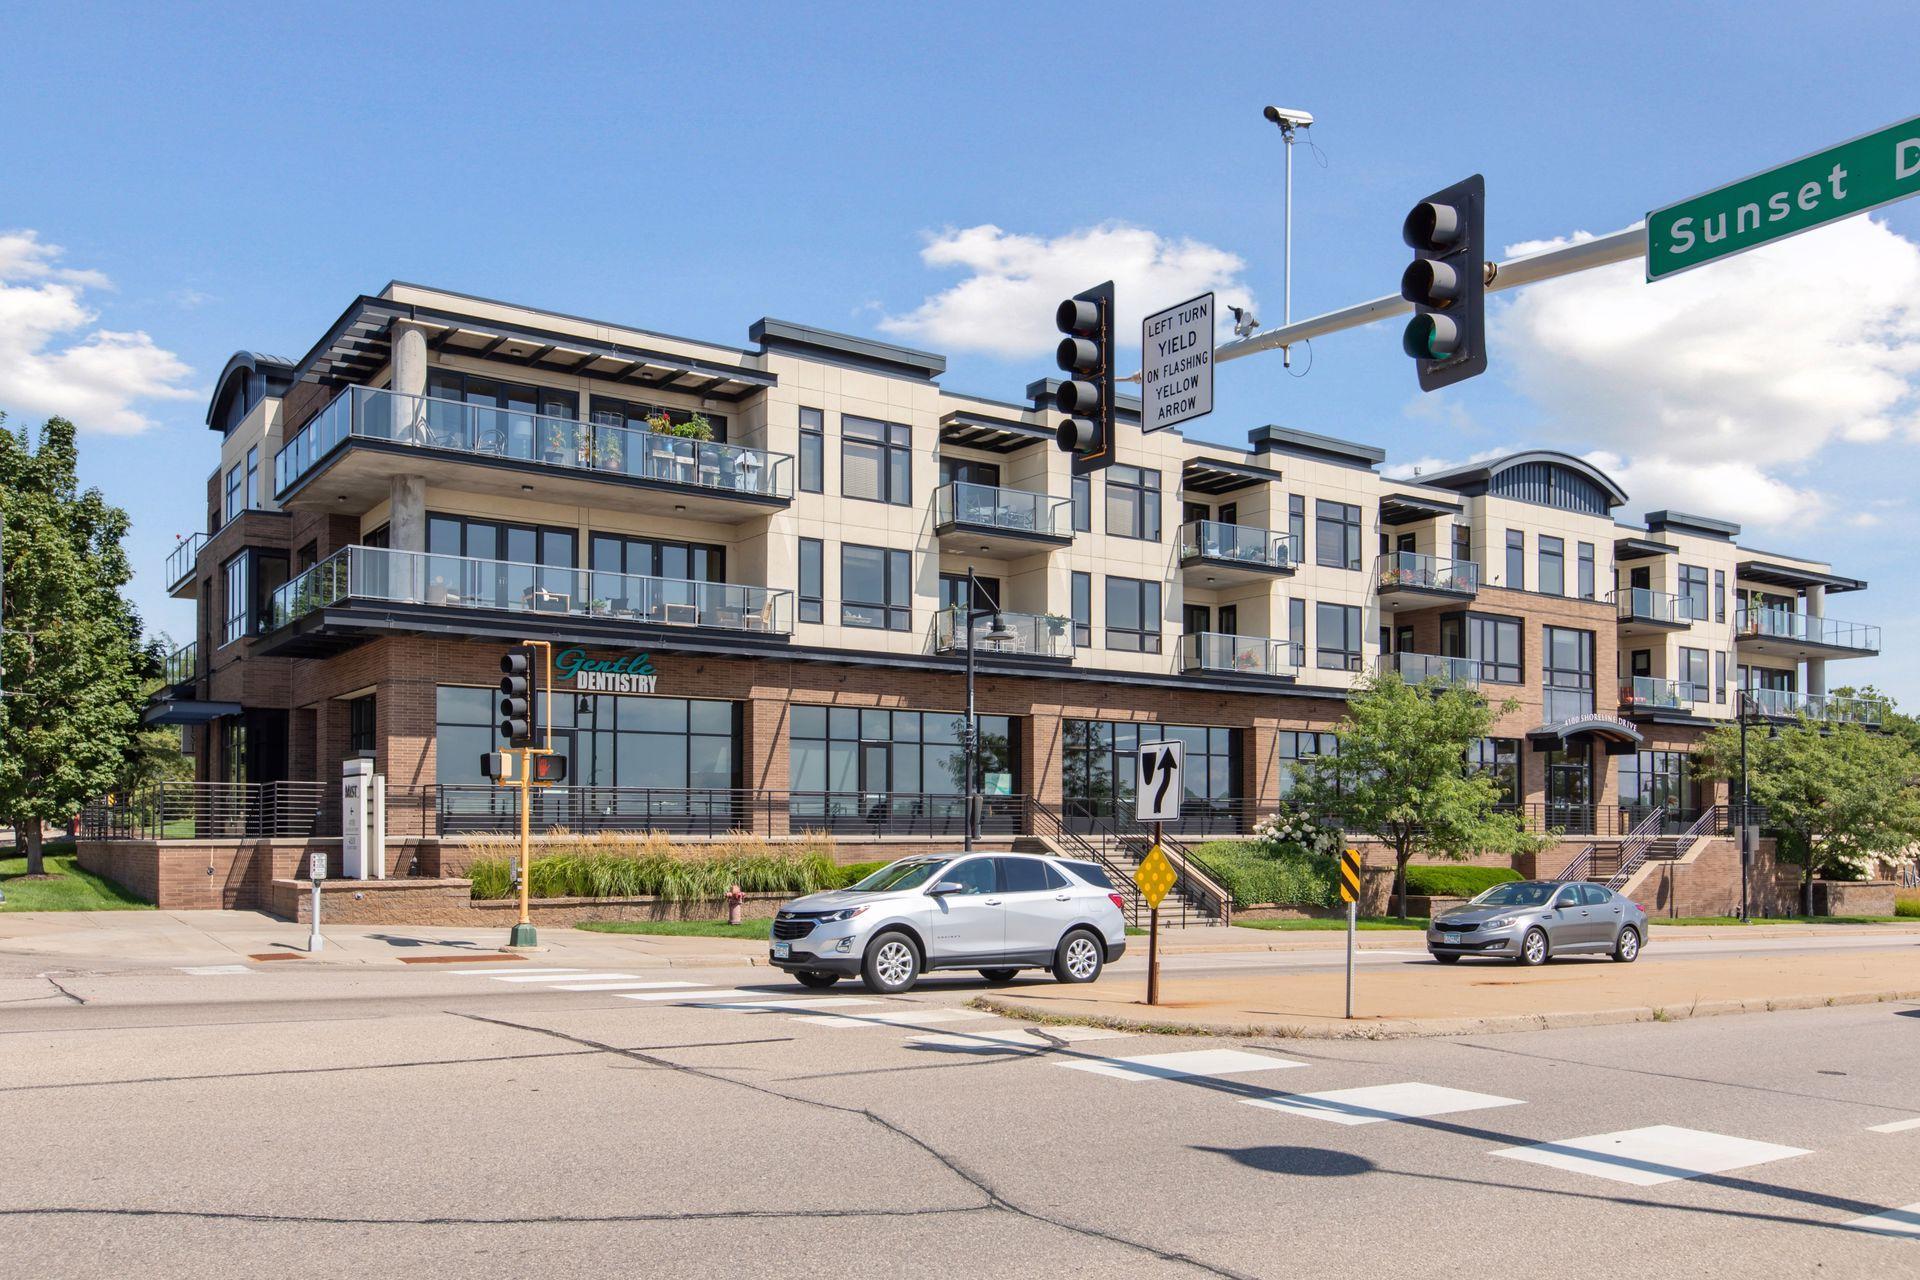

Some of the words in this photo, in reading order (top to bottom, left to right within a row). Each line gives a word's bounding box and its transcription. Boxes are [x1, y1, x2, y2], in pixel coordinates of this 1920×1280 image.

[1669, 163, 1847, 254] Sunset
[1148, 316, 1173, 338] LEFT
[1179, 303, 1207, 326] TURN
[1158, 330, 1197, 357] YIELD
[1147, 368, 1159, 384] ON
[1163, 351, 1208, 379] FLASHING
[1155, 374, 1199, 400] YELLOW
[1157, 396, 1196, 420] ARROW
[555, 648, 656, 680] Gentle
[577, 671, 657, 693] DENTISTRY
[1581, 713, 1618, 723] SHORELINE
[1618, 717, 1637, 732] DRIVE
